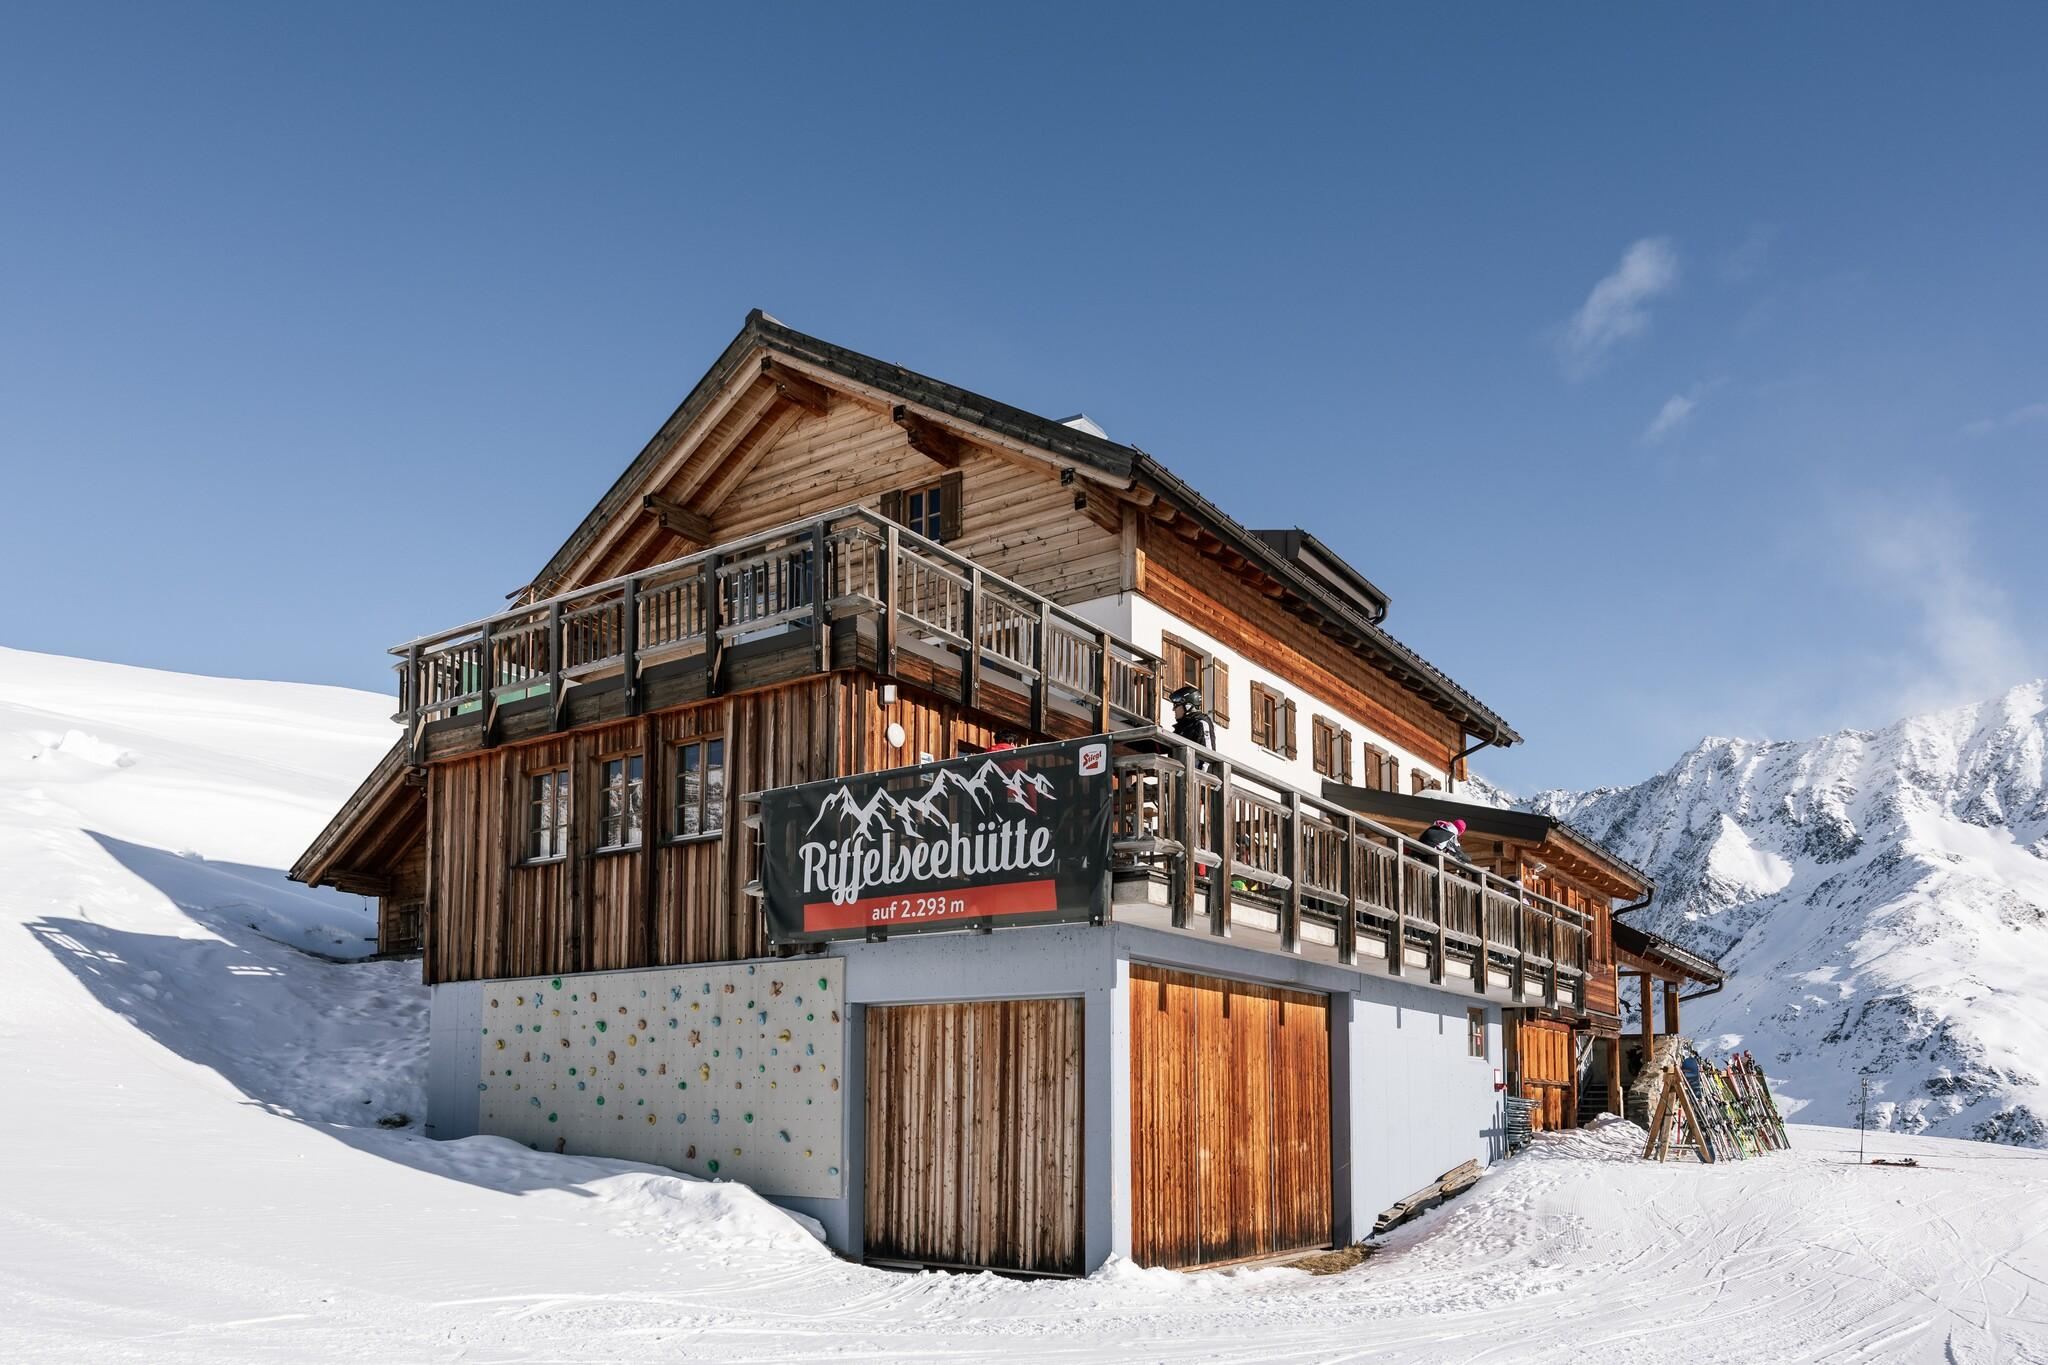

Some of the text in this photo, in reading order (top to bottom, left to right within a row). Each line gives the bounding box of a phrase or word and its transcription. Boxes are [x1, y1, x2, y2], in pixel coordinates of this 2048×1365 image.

[799, 818, 1055, 905] Riffelseehütte
[872, 896, 965, 920] auf 2.293 m
